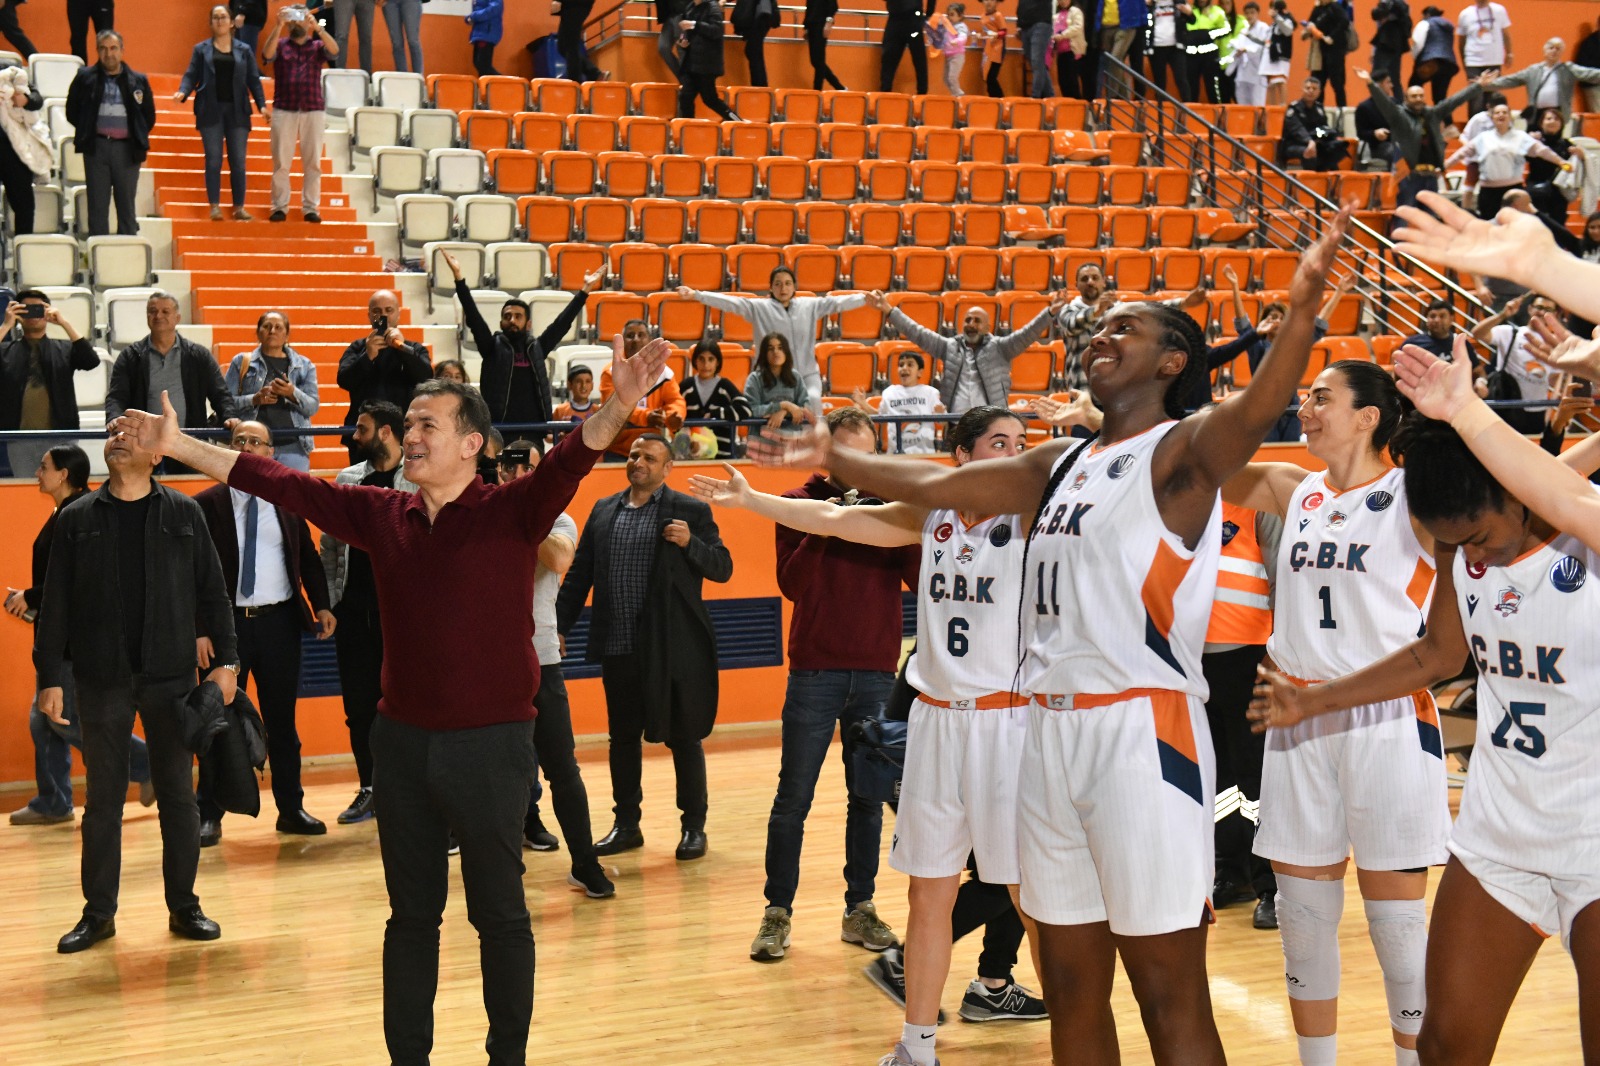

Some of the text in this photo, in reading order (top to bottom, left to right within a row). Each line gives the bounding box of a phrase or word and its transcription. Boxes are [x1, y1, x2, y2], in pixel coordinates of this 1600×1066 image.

[1289, 541, 1371, 573] Ç.B.K
[929, 572, 996, 604] Ç.B.K
[1035, 561, 1060, 616] 11
[1318, 585, 1337, 630] 1
[947, 616, 970, 658] 6
